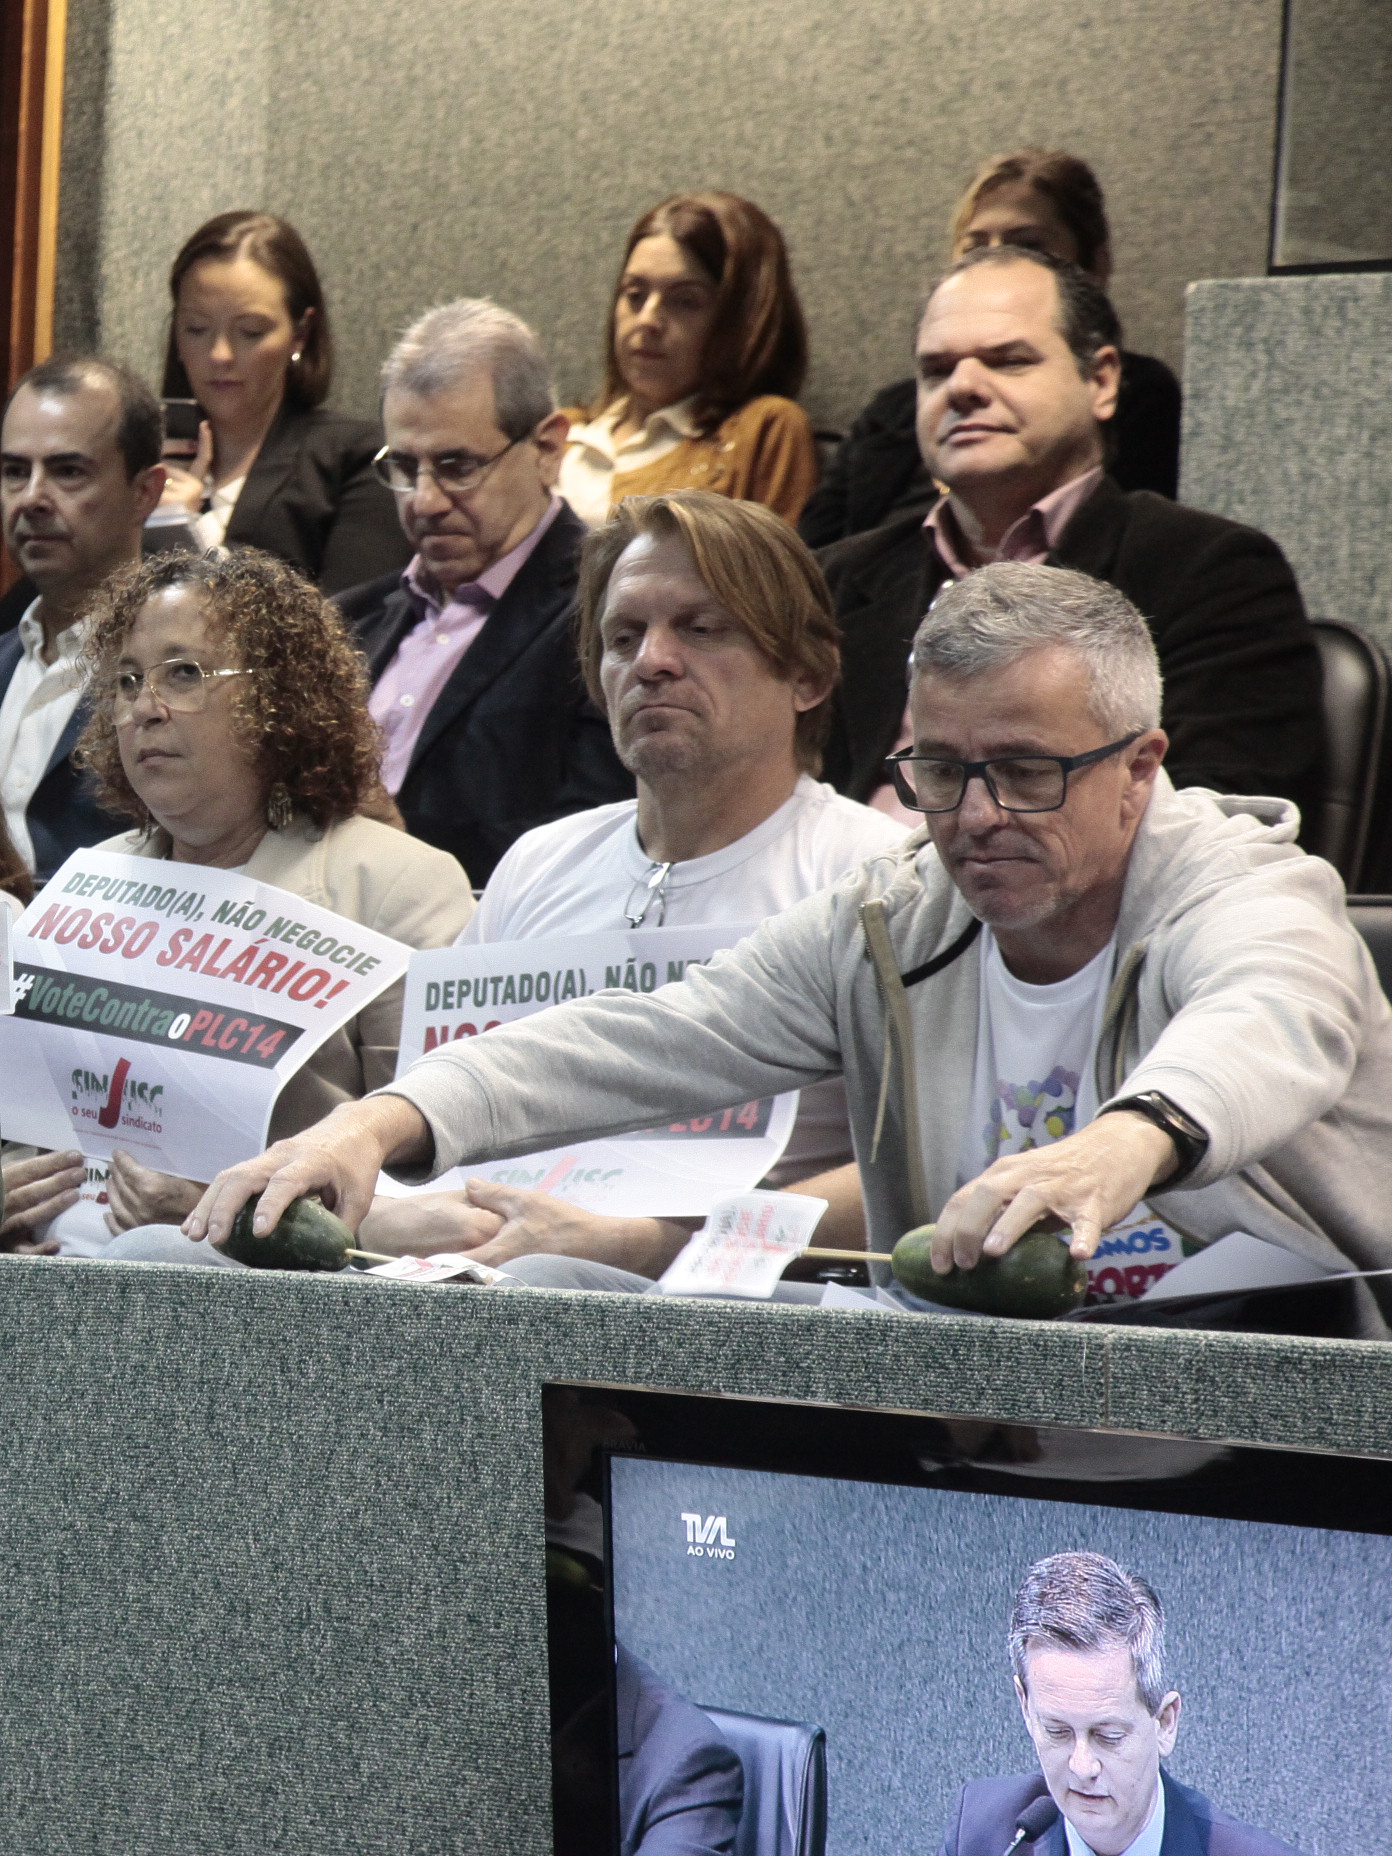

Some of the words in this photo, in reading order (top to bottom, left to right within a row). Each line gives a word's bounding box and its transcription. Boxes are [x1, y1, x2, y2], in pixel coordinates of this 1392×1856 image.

[62, 872, 206, 922] DEPUTADO(A),
[210, 898, 268, 932] NÃO
[264, 916, 381, 977] NEGOCIE
[28, 903, 160, 960] NOSSO
[156, 927, 350, 1010] SALÁRIO!
[605, 958, 656, 993] NÃO
[14, 973, 287, 1060] #VoteContraoPLC14
[121, 1115, 162, 1134] sindicato
[687, 1545, 704, 1557] AO
[706, 1547, 735, 1560] VIVO
